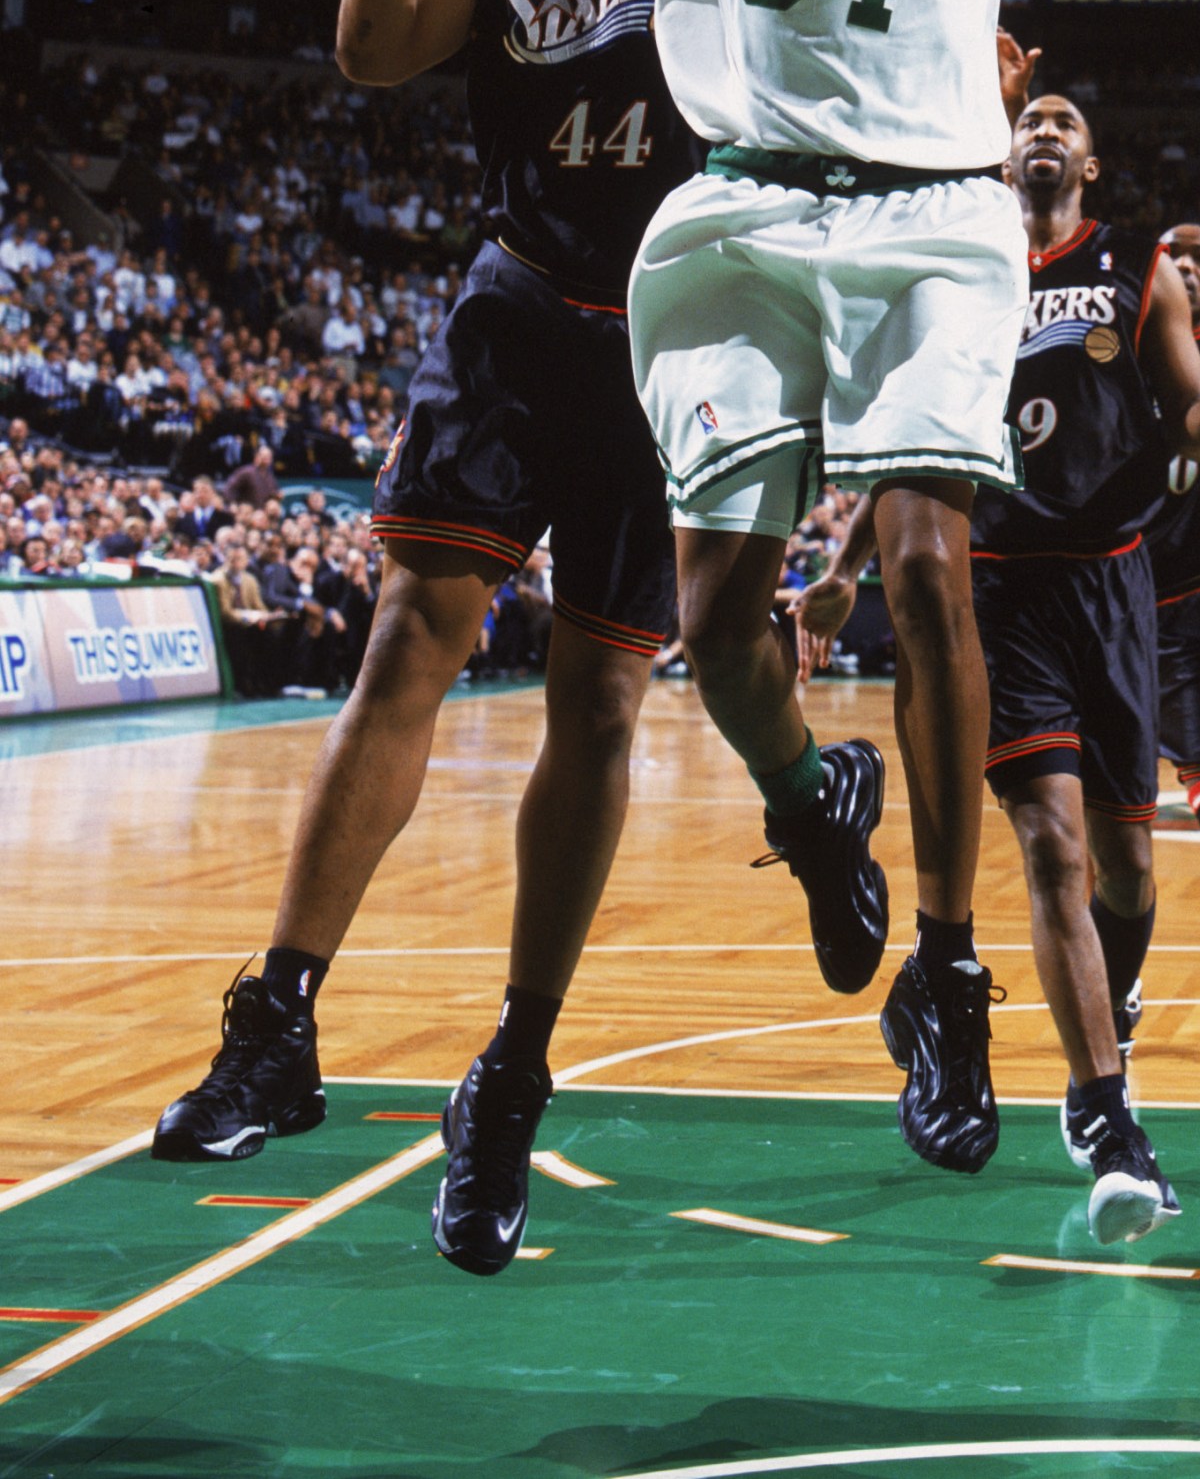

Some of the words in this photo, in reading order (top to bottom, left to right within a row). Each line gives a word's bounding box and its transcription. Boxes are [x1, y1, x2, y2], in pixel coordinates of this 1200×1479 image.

[548, 97, 653, 169] 44
[1017, 396, 1059, 453] 9
[69, 634, 121, 677] THIS
[123, 629, 203, 673] SUMMER
